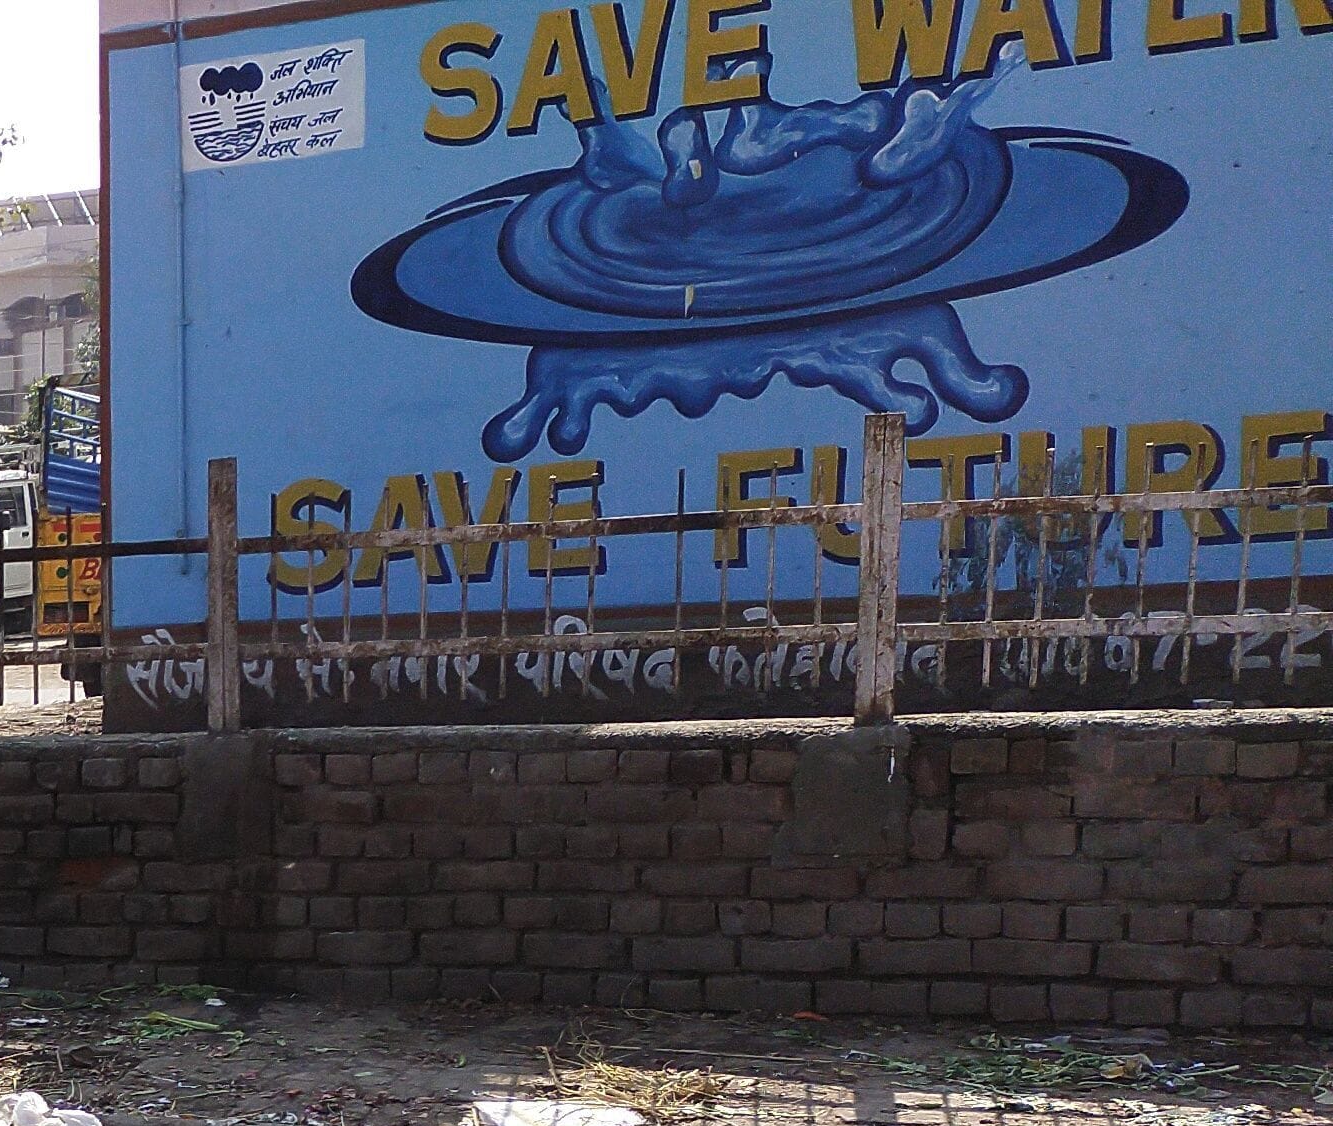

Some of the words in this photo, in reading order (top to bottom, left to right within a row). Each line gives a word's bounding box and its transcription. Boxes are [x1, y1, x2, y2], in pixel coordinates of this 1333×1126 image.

[270, 59, 301, 81] जल
[304, 48, 353, 75] शक्ति
[419, 0, 770, 146] SAVE
[273, 79, 339, 107] अभियान
[269, 114, 306, 137] संचय
[308, 108, 343, 126] जल
[257, 138, 300, 158] बेहतर
[306, 130, 342, 148] कल
[267, 460, 607, 595] SAVE
[713, 411, 1333, 568] FUTURE
